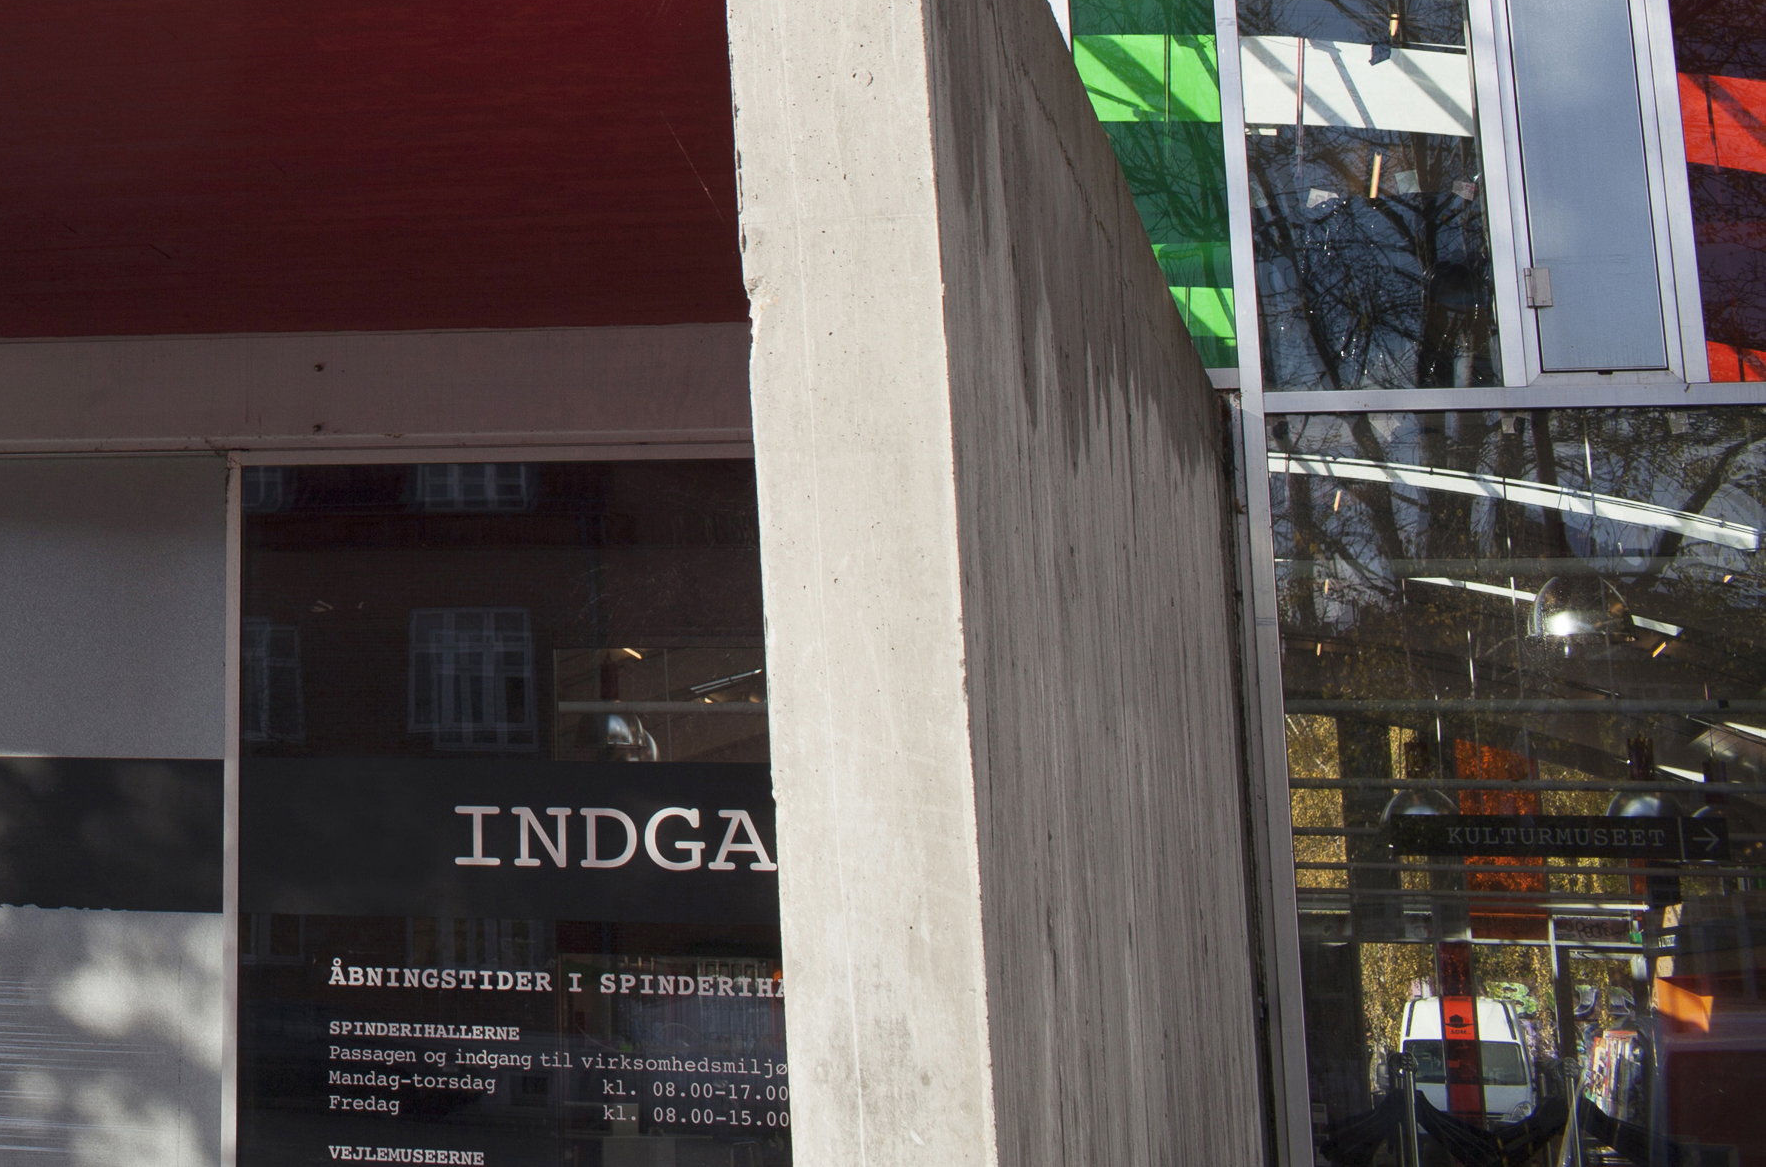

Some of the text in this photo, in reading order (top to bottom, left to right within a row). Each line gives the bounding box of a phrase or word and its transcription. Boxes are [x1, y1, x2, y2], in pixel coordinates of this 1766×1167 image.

[1446, 826, 1666, 848] KULTURMUSEET
[328, 957, 552, 991] ÅBNINGSTIDER
[568, 972, 583, 993] I
[329, 1020, 520, 1040] SPINDERIHALLERNE
[329, 1045, 417, 1065] Passagen
[423, 1051, 447, 1067] og
[455, 1048, 532, 1070] indgang
[540, 1052, 573, 1068] til
[329, 1070, 790, 1101] Mandag-torsdag kl. 08.00-17.00
[329, 1095, 791, 1127] Fredag kl. 08.00-15.00
[328, 1145, 485, 1166] VEJLEMUSEERNE
